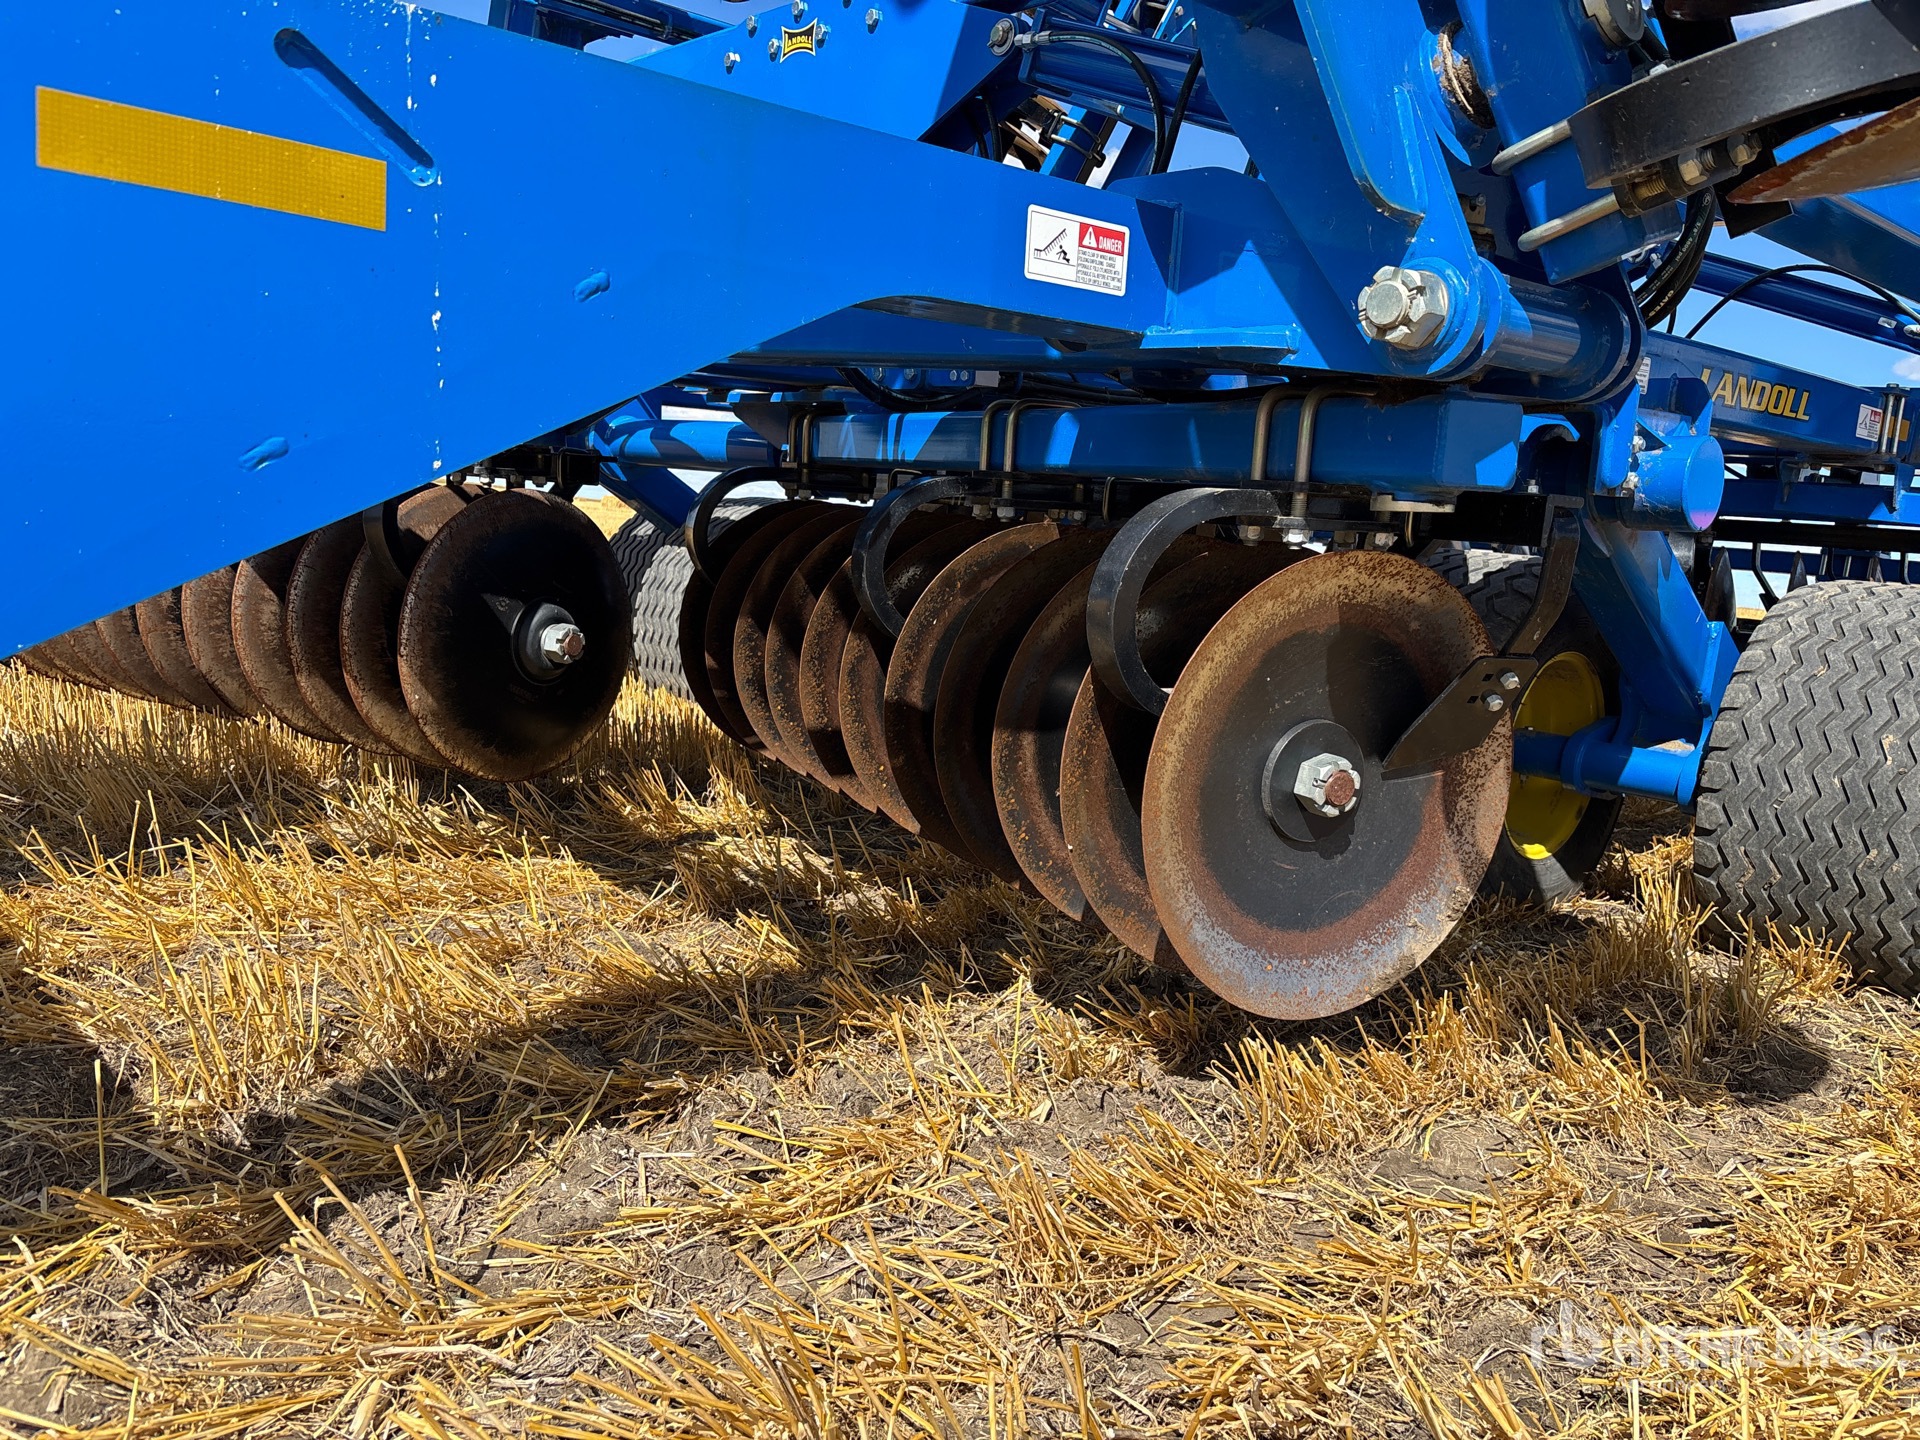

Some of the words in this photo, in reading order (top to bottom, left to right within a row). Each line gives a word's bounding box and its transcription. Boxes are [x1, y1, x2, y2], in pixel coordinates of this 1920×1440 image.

[784, 33, 812, 54] LANDOLL
[1098, 236, 1123, 253] DANGER
[1648, 289, 1675, 318] GATES
